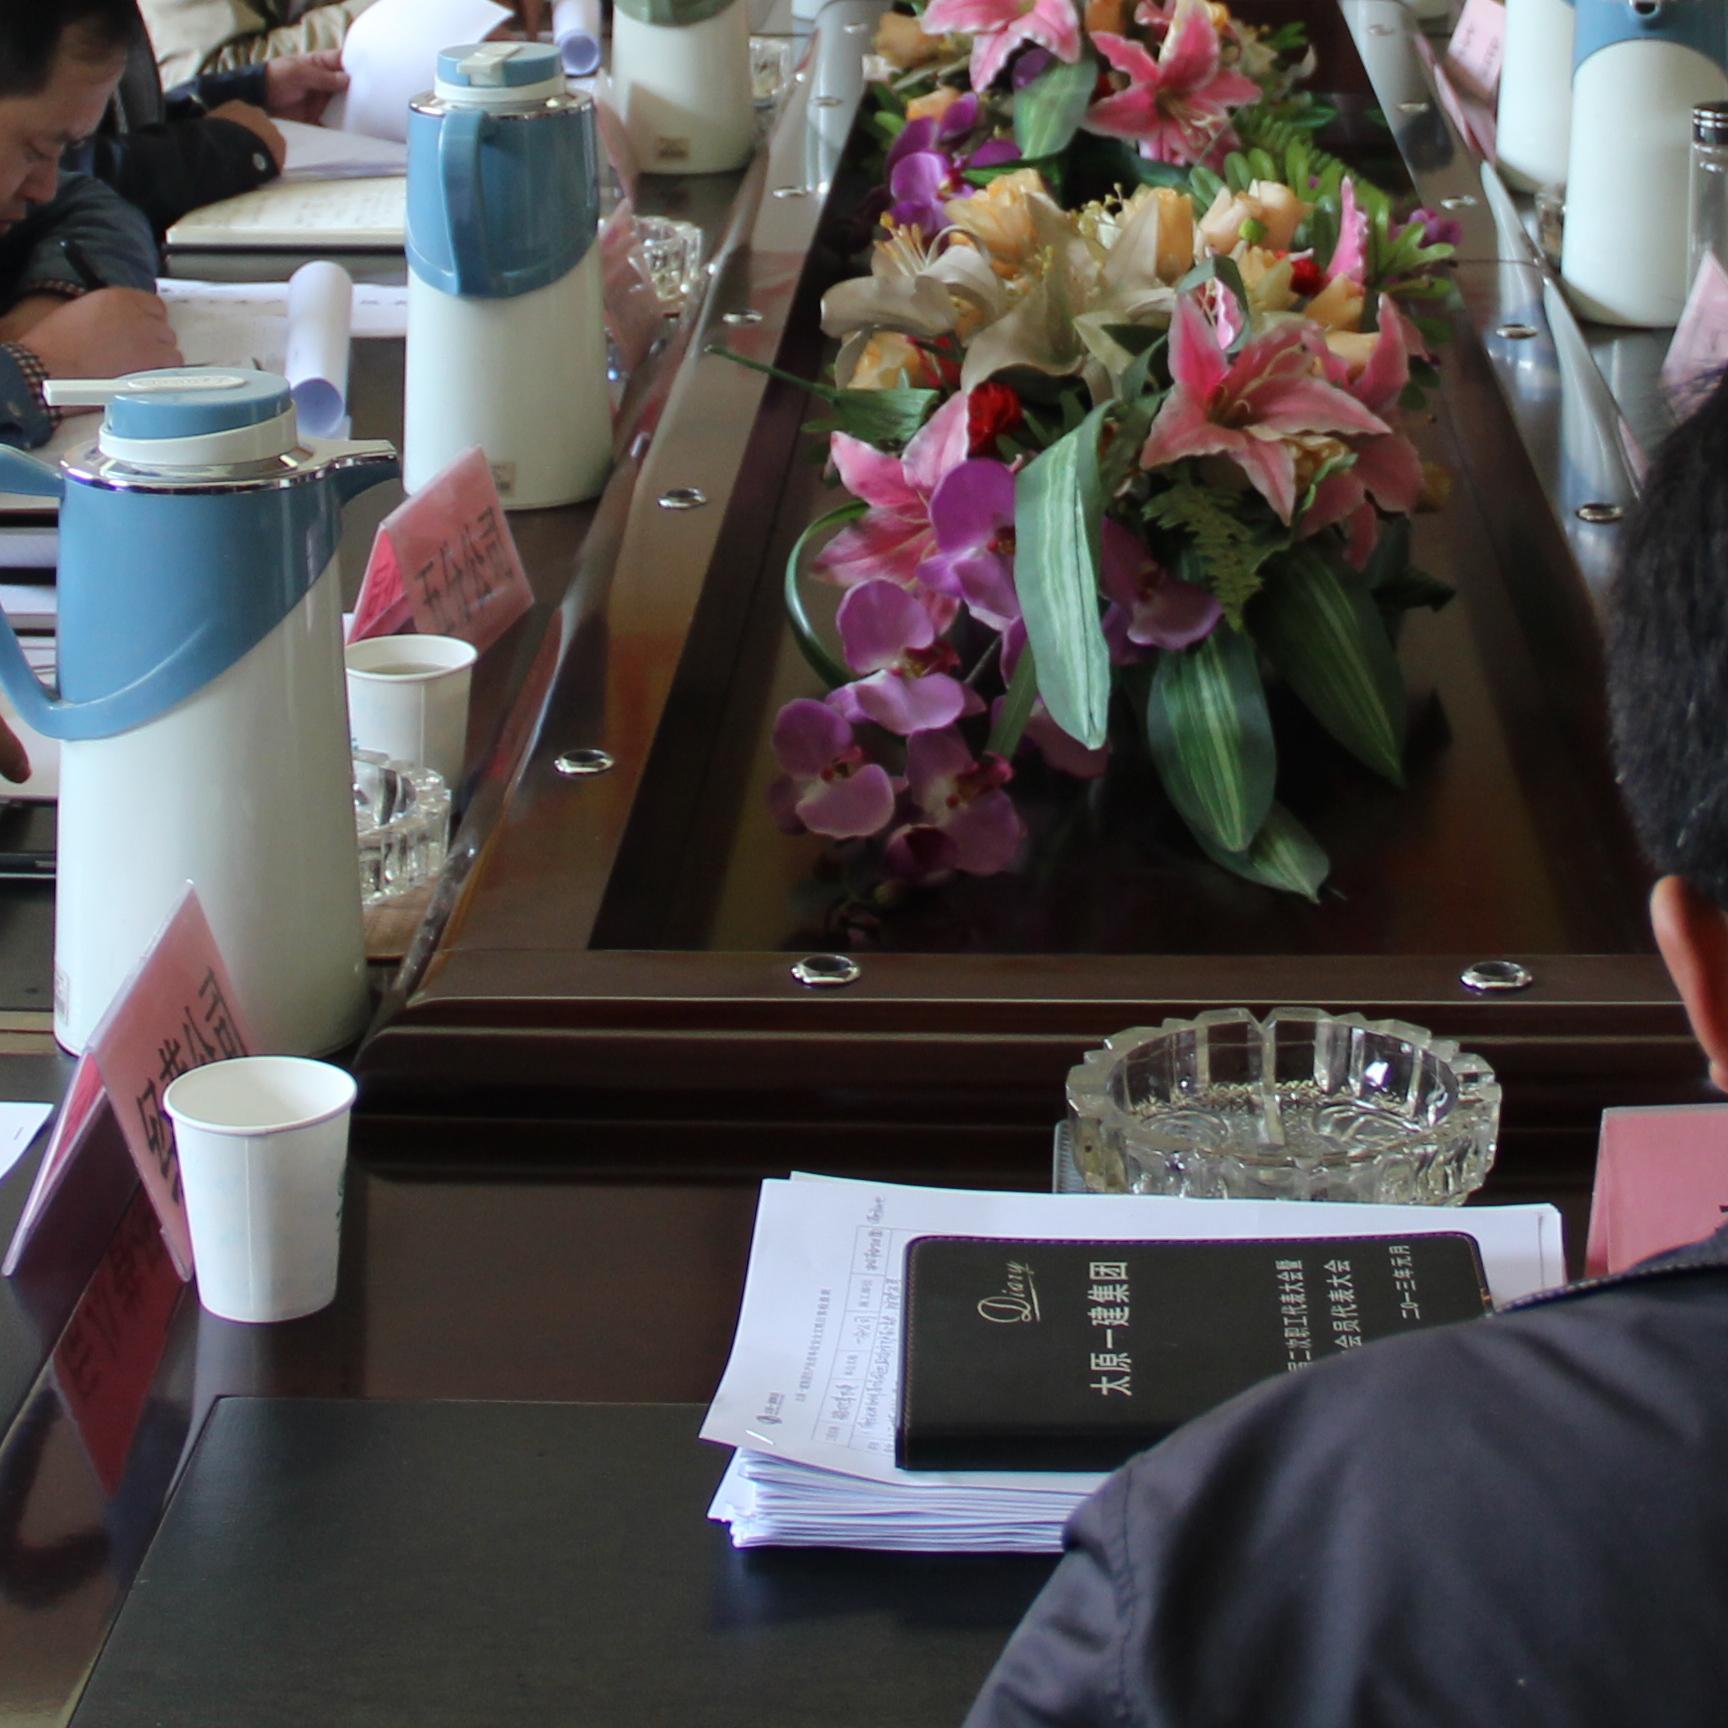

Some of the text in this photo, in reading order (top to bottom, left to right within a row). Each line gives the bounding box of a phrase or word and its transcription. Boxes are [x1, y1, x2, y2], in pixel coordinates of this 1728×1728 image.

[976, 1260, 1040, 1323] Diary
[1087, 1261, 1133, 1396] 太原一建集团
